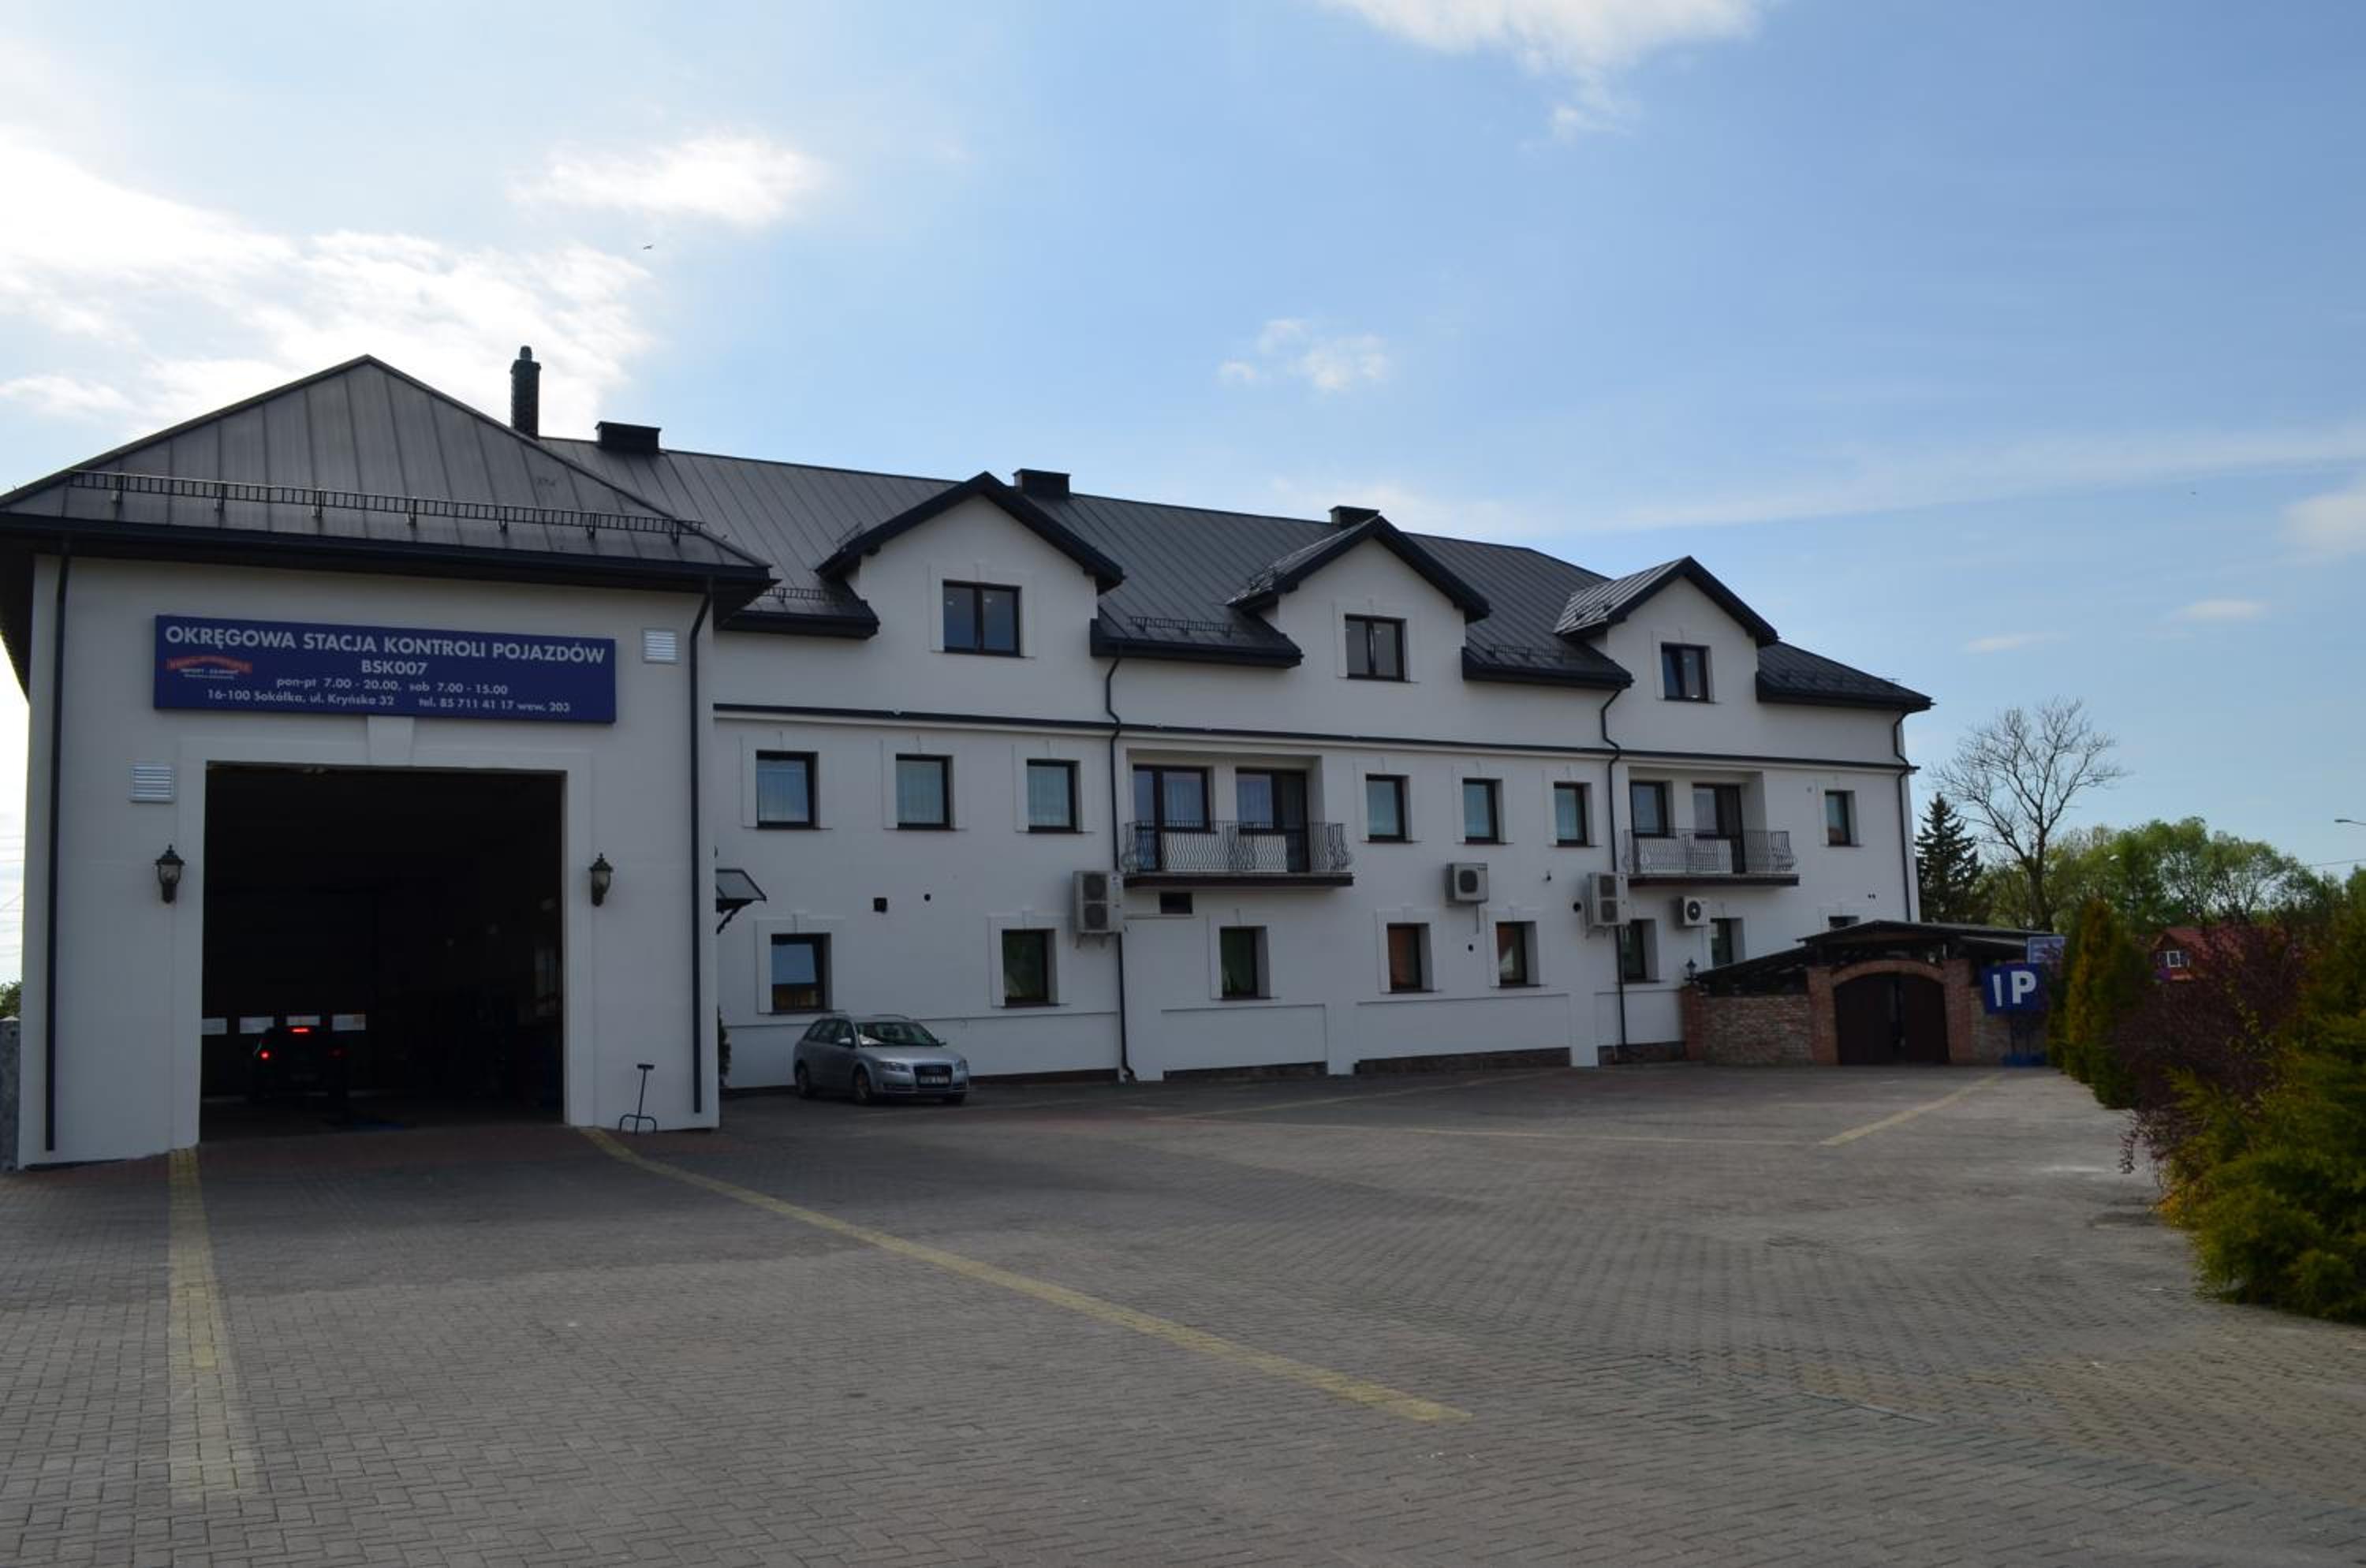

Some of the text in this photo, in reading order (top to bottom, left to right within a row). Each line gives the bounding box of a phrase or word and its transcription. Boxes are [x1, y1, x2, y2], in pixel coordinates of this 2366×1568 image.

[166, 625, 606, 663] OKRĘGOWA STACJA KONTROLI POJAZDÓW
[361, 660, 428, 676] BSK007
[277, 678, 316, 689] pon-pt
[324, 678, 352, 689] 7.00
[437, 682, 464, 693] 7.00
[476, 684, 509, 695] 15.00
[207, 689, 251, 700] 16-100
[310, 693, 324, 703] ul.
[328, 694, 377, 707] Kryńska
[379, 695, 395, 706] 32
[418, 696, 436, 707] tel.
[440, 698, 454, 707] 85
[457, 699, 478, 709] 711
[482, 699, 495, 710] 41
[502, 700, 514, 710] 17
